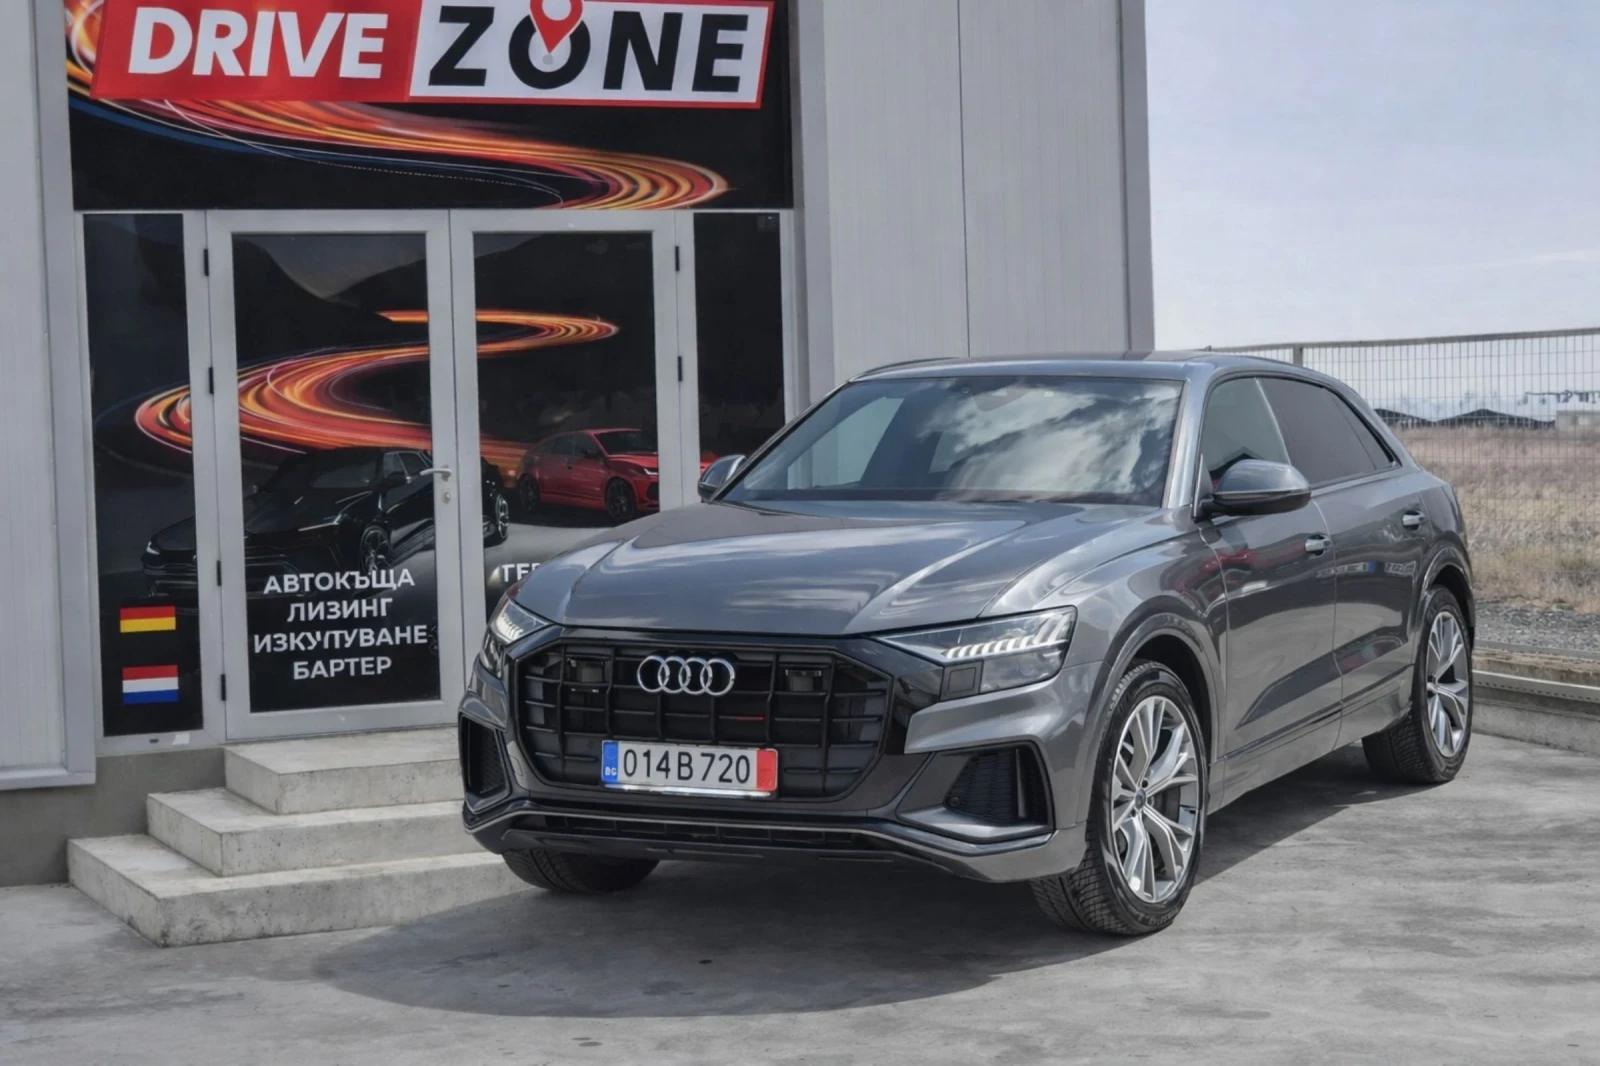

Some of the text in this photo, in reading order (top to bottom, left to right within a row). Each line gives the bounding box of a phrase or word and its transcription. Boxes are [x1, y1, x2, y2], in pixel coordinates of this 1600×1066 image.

[128, 6, 749, 92] DRIVE ZONE
[264, 568, 415, 595] АВТОКЪЩА
[501, 562, 541, 583] ТЕ
[287, 598, 393, 622] ЛИЗИНГ
[294, 656, 392, 680] БАРТЕР
